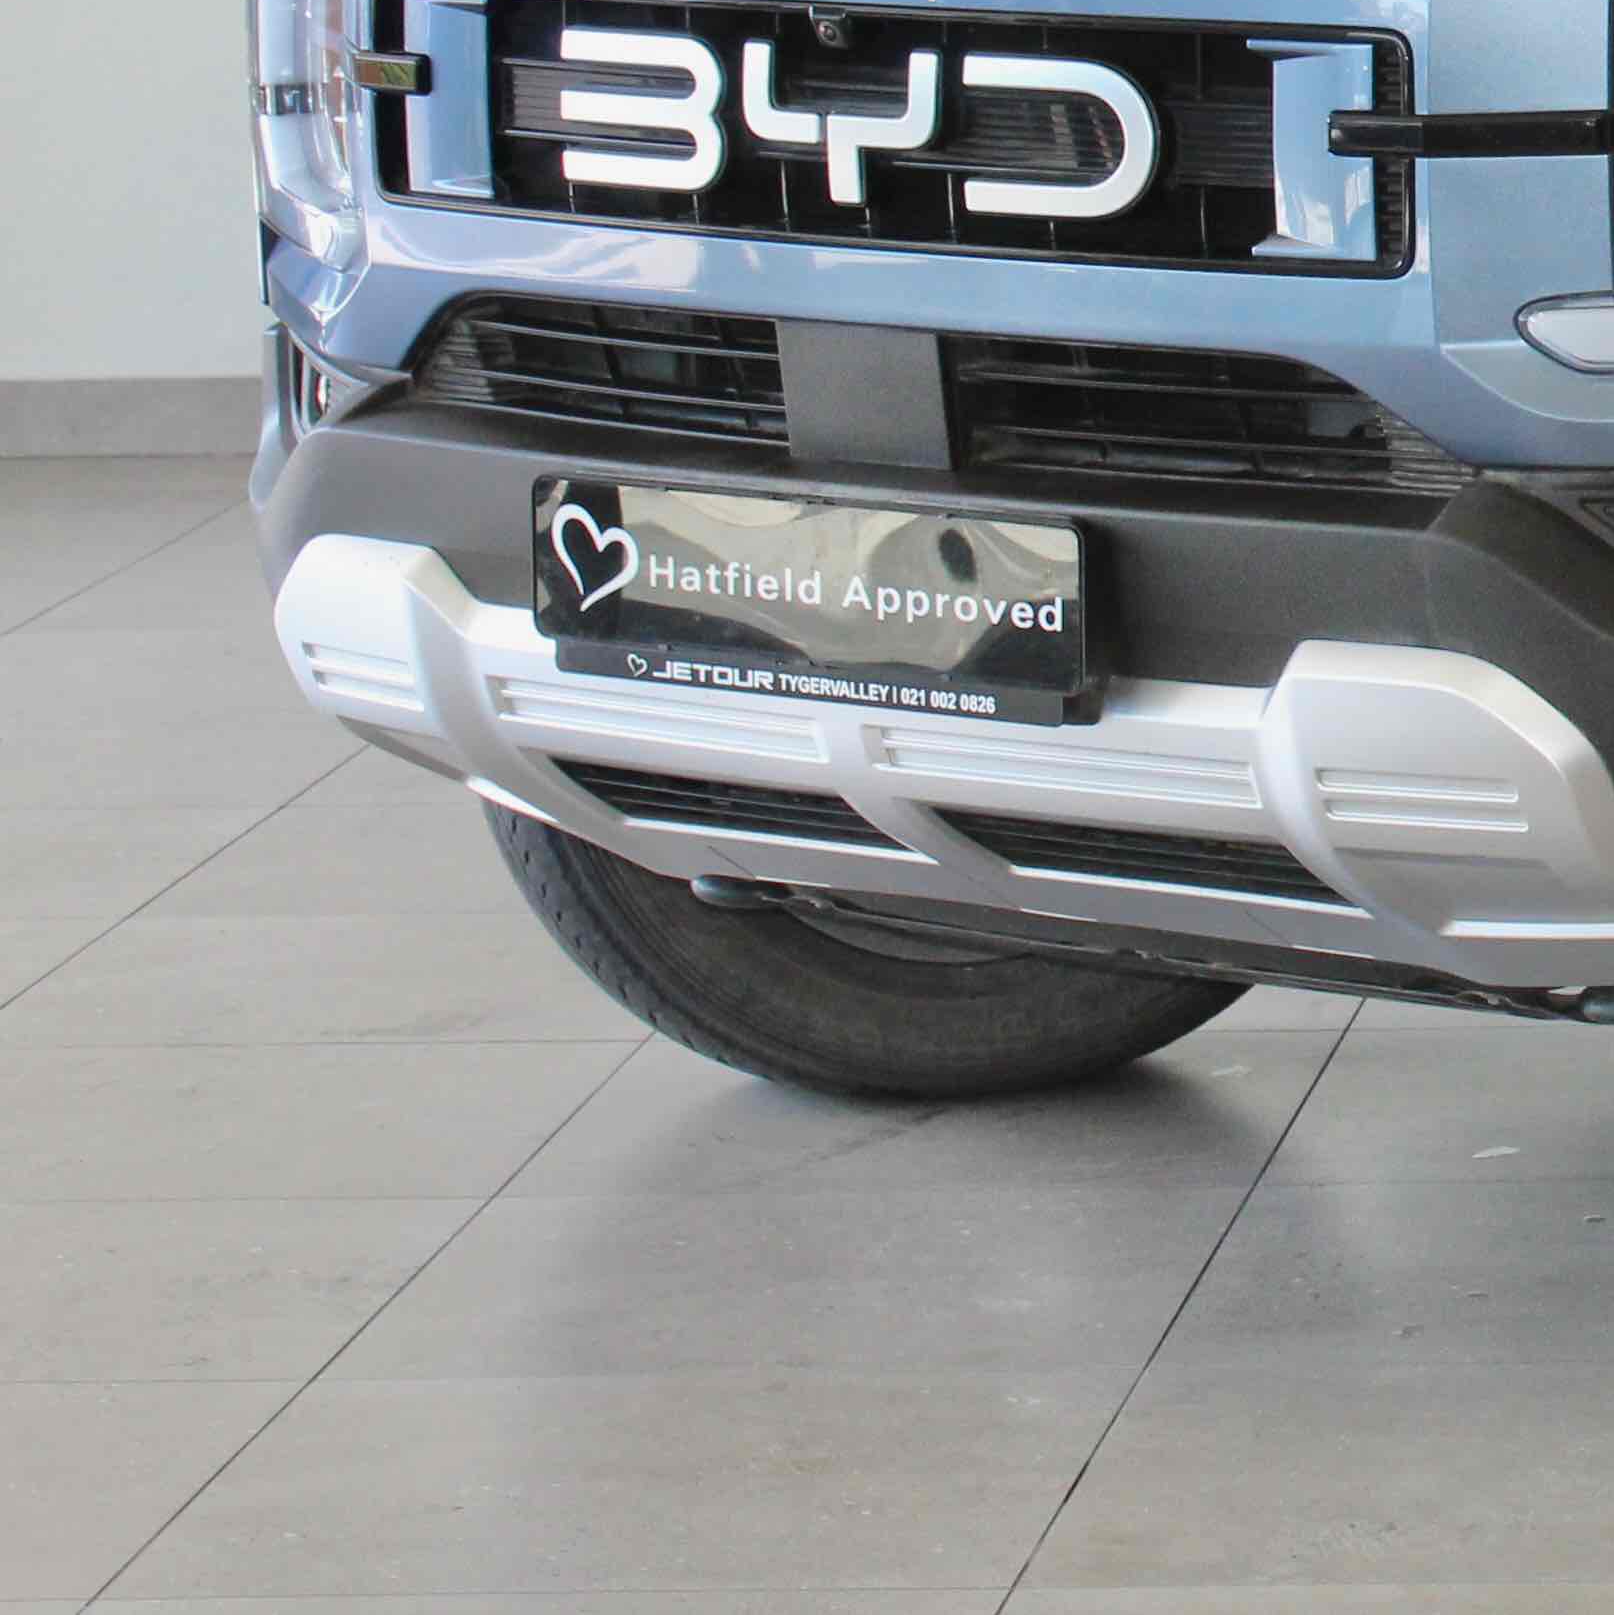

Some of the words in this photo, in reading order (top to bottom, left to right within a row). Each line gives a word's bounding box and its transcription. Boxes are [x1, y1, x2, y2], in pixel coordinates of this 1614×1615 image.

[559, 27, 1158, 219] BYD
[647, 553, 823, 607] Hatfield
[840, 573, 1066, 634] Approved
[652, 659, 775, 691] JETOUR
[779, 673, 889, 703] TYGERVALLEY
[900, 686, 927, 708] 021
[930, 691, 957, 710] 002
[960, 693, 996, 716] 0826
